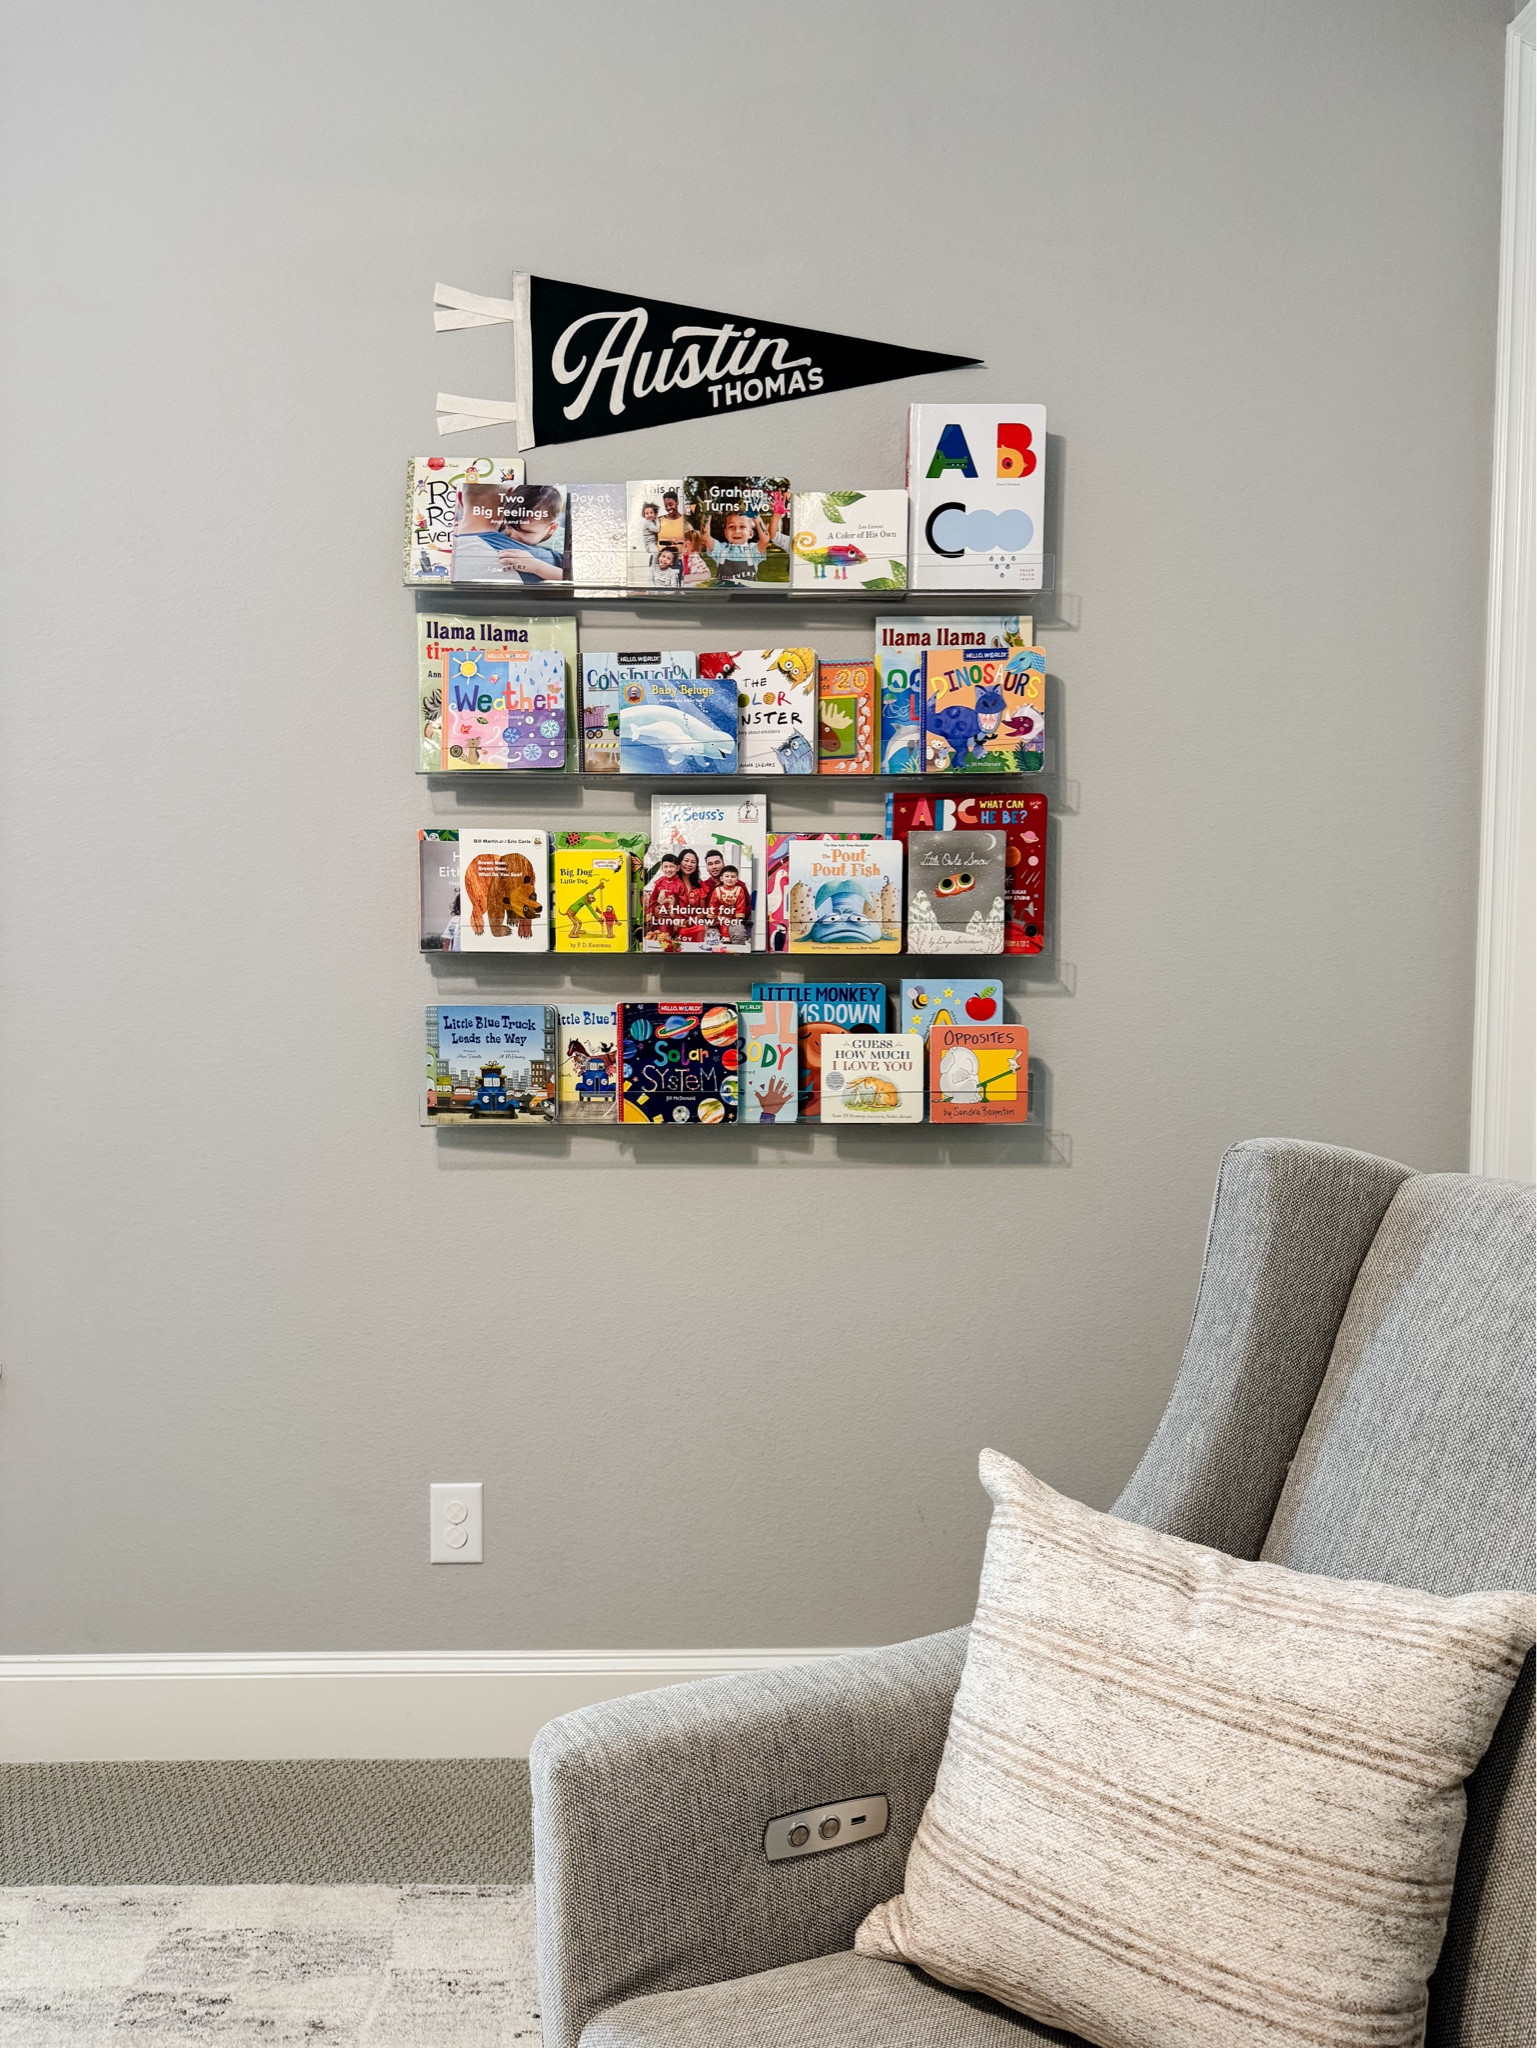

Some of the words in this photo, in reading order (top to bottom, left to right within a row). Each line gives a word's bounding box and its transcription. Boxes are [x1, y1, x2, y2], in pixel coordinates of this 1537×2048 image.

[552, 307, 812, 420] Austin
[708, 368, 824, 408] THOMAS
[925, 424, 979, 478] A
[996, 423, 1037, 478] B
[499, 493, 525, 504] Two
[709, 485, 764, 499] Graham
[472, 506, 493, 518] Big
[497, 507, 549, 520] Feelings
[704, 500, 739, 512] Turns
[744, 500, 770, 512] Two
[827, 532, 834, 540] A
[835, 532, 856, 540] Color
[856, 531, 865, 539] of
[865, 530, 879, 539] His
[880, 530, 897, 538] Own
[925, 502, 966, 558] C
[426, 621, 475, 641] llama
[480, 624, 529, 642] llama
[882, 628, 931, 646] llama
[936, 628, 986, 646] llama
[742, 677, 768, 688] THE
[834, 668, 869, 691] 20
[929, 663, 1042, 700] DINOSAURS
[454, 681, 558, 713] Weather
[652, 684, 677, 697] Baby
[680, 685, 715, 698] Beluga
[682, 808, 725, 822] Seuss's
[911, 798, 979, 831] ABC
[979, 800, 1003, 809] WHAT
[1005, 800, 1024, 809] CAN
[981, 810, 997, 824] HE
[1001, 810, 1028, 824] BE?
[920, 851, 940, 866] Little
[964, 852, 992, 866] Snow
[560, 868, 574, 878] Big
[811, 863, 848, 877] Pout
[850, 862, 881, 877] Fish
[658, 905, 669, 914] A
[670, 904, 715, 914] Haircut
[718, 904, 736, 914] for
[652, 916, 685, 926] Lunar
[688, 916, 713, 926] New
[718, 916, 744, 926] Year
[759, 987, 812, 1001] LITTLE
[815, 987, 880, 1001] MONKEY
[583, 1011, 610, 1026] Blue
[823, 1004, 881, 1024] DOWN
[443, 1015, 474, 1030] Little
[475, 1016, 500, 1030] Blue
[500, 1015, 536, 1031] Truck
[451, 1033, 481, 1044] Leads
[485, 1032, 502, 1044] the
[504, 1033, 527, 1047] Way
[852, 1039, 893, 1049] GUESS
[944, 1030, 1015, 1045] OPPOSITES
[654, 1040, 709, 1067] Solar
[835, 1050, 866, 1059] HOW
[870, 1050, 910, 1060] MUCH
[832, 1061, 837, 1071] I
[843, 1061, 880, 1071] LOVE
[882, 1061, 913, 1071] YOU
[943, 1108, 953, 1119] by
[953, 1107, 981, 1116] Sandra
[981, 1107, 1015, 1118] Boynton
